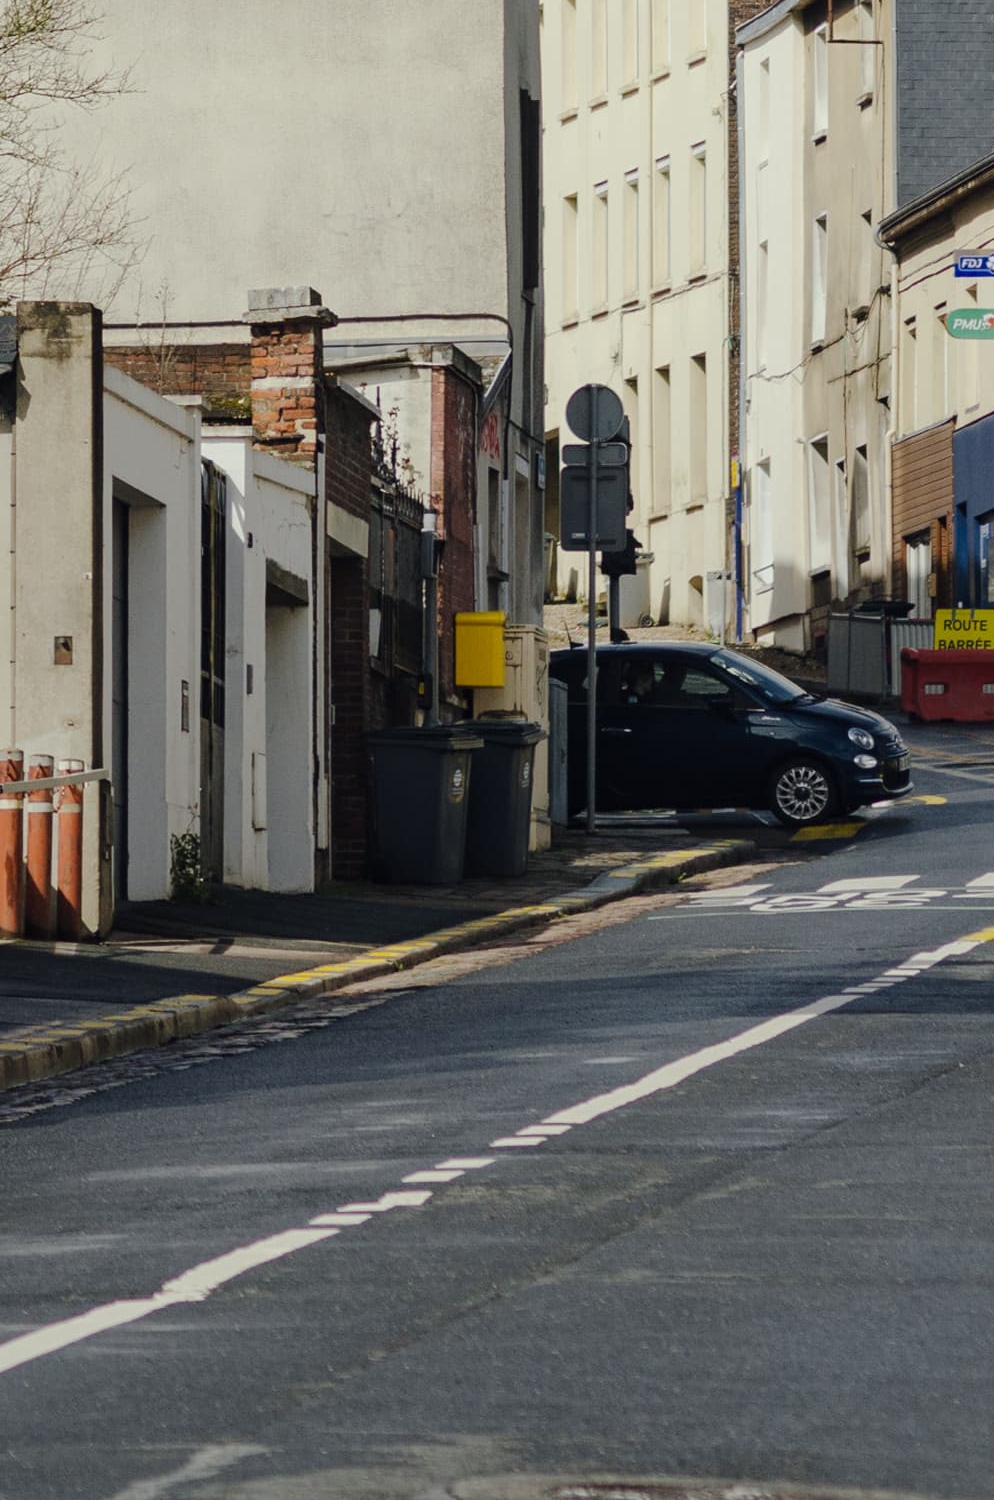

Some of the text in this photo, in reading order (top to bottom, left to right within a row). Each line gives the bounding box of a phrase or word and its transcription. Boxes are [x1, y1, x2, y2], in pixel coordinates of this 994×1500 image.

[961, 258, 983, 269] FDJ
[952, 318, 982, 331] PMU
[943, 619, 988, 632] ROUTE
[938, 636, 992, 651] BARRÉE
